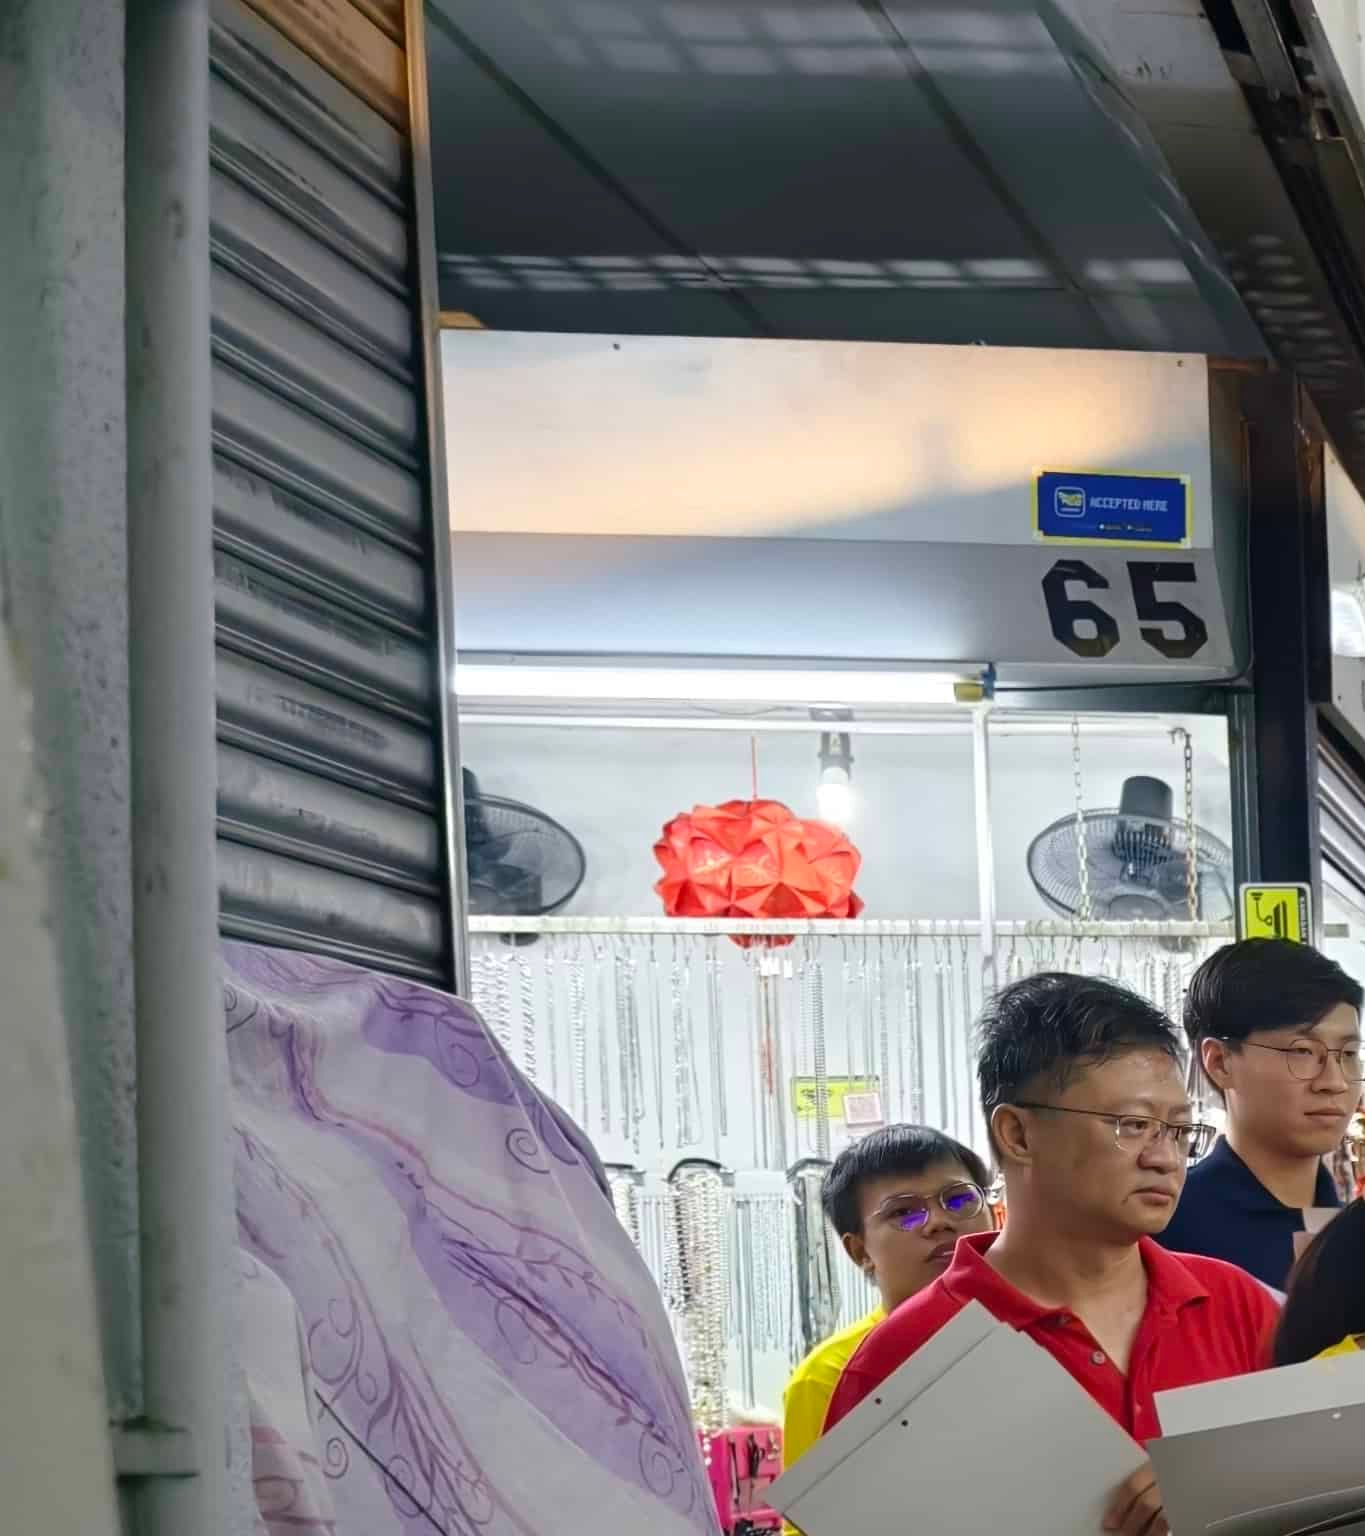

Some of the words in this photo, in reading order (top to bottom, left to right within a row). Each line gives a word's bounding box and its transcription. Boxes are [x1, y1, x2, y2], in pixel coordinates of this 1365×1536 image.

[1089, 496, 1141, 511] ACCEPTED
[1142, 499, 1169, 513] HERE
[1041, 559, 1209, 659] 65
